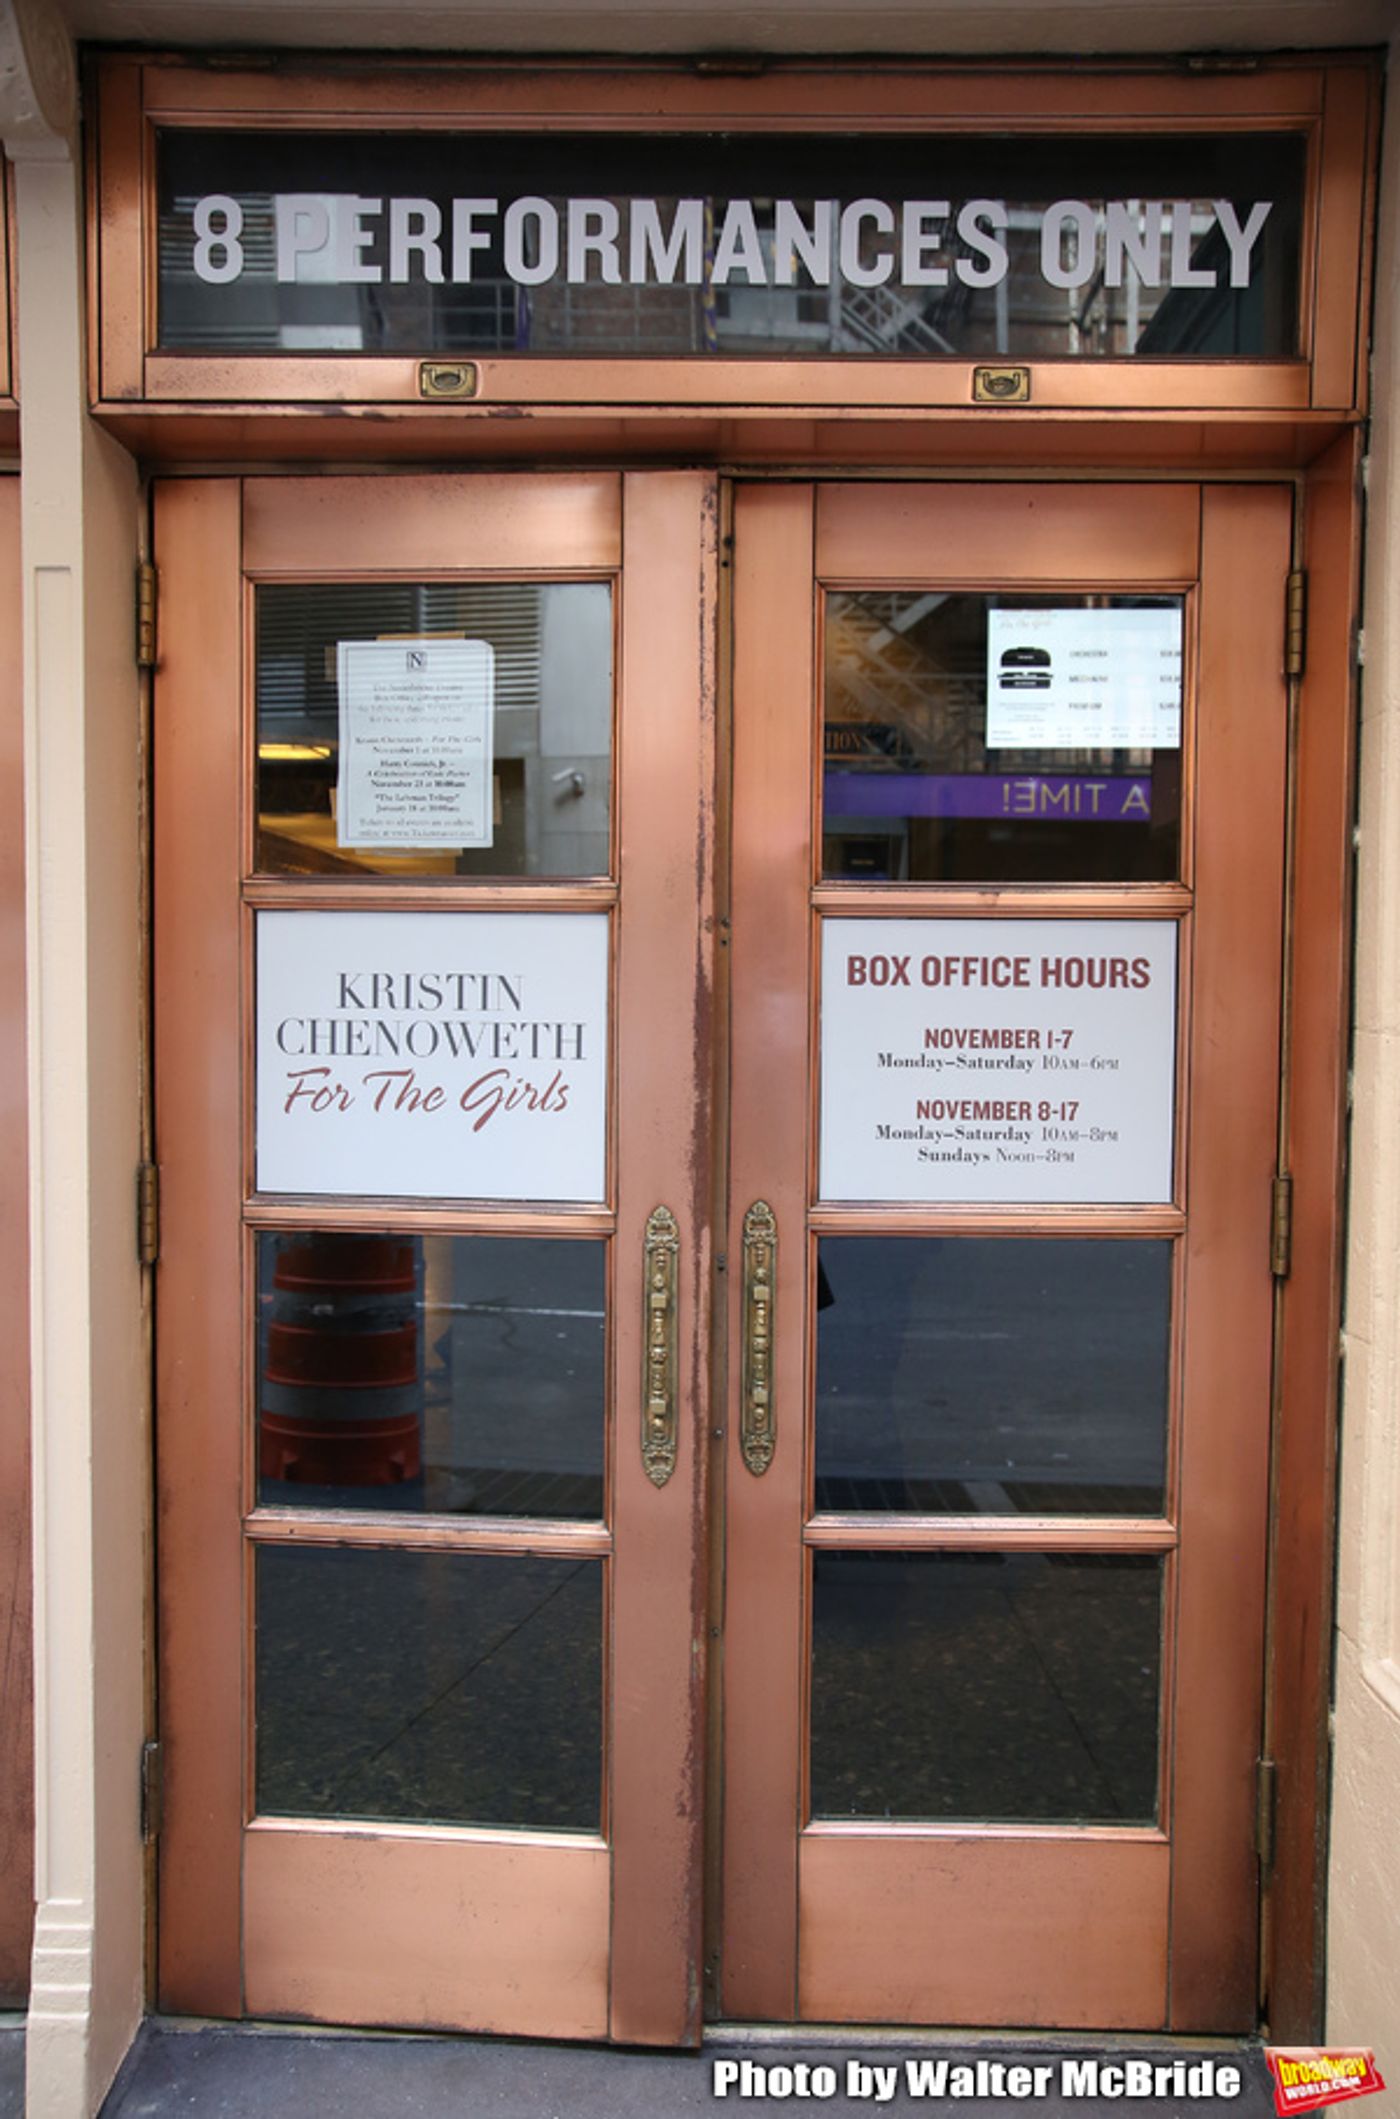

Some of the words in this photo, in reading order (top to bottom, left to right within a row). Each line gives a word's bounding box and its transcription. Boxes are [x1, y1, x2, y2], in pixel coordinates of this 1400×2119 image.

[193, 195, 245, 284] 8
[276, 196, 1009, 288] PERFORMANCES
[1041, 199, 1273, 289] ONLY
[847, 956, 911, 987] BOX
[921, 956, 1031, 987] OFFICE
[1040, 957, 1151, 989] HOURS
[336, 972, 525, 1012] KRISTIN
[276, 1018, 587, 1060] CHENOWETH
[924, 1028, 1041, 1049] NOVEMBER
[1047, 1029, 1075, 1050] 1-7
[284, 1066, 356, 1114] For
[362, 1068, 447, 1113] The
[459, 1068, 570, 1133] Girls
[916, 1099, 1032, 1121] NOVEMBER
[1037, 1101, 1080, 1121] 8-17
[917, 1146, 991, 1166] Sundays
